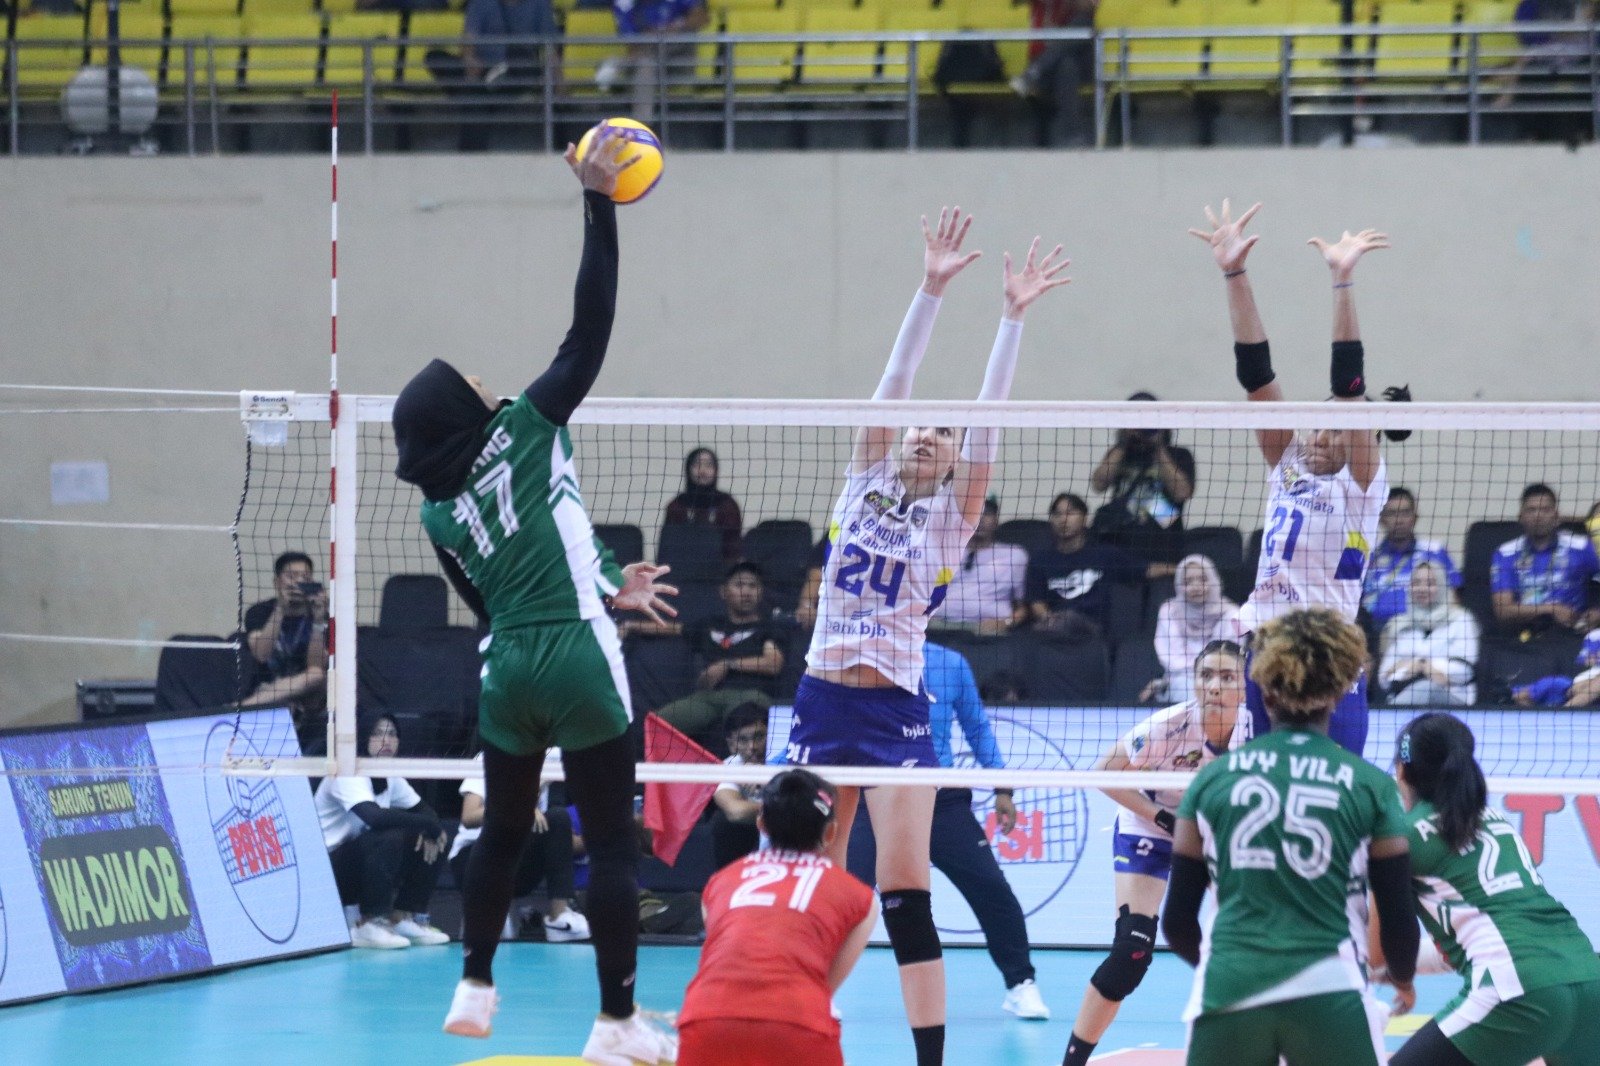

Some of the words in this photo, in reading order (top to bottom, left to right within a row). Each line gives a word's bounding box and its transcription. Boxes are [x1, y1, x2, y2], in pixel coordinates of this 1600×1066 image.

[451, 460, 520, 560] 17
[1265, 506, 1304, 562] 21
[834, 542, 906, 609] 24
[48, 786, 97, 817] SARUNG
[93, 781, 135, 811] TENUN
[1228, 750, 1277, 773] IVY
[1289, 754, 1354, 791] VILA
[1229, 774, 1340, 880] 25
[44, 846, 190, 933] WADIMOR
[730, 863, 824, 914] 21
